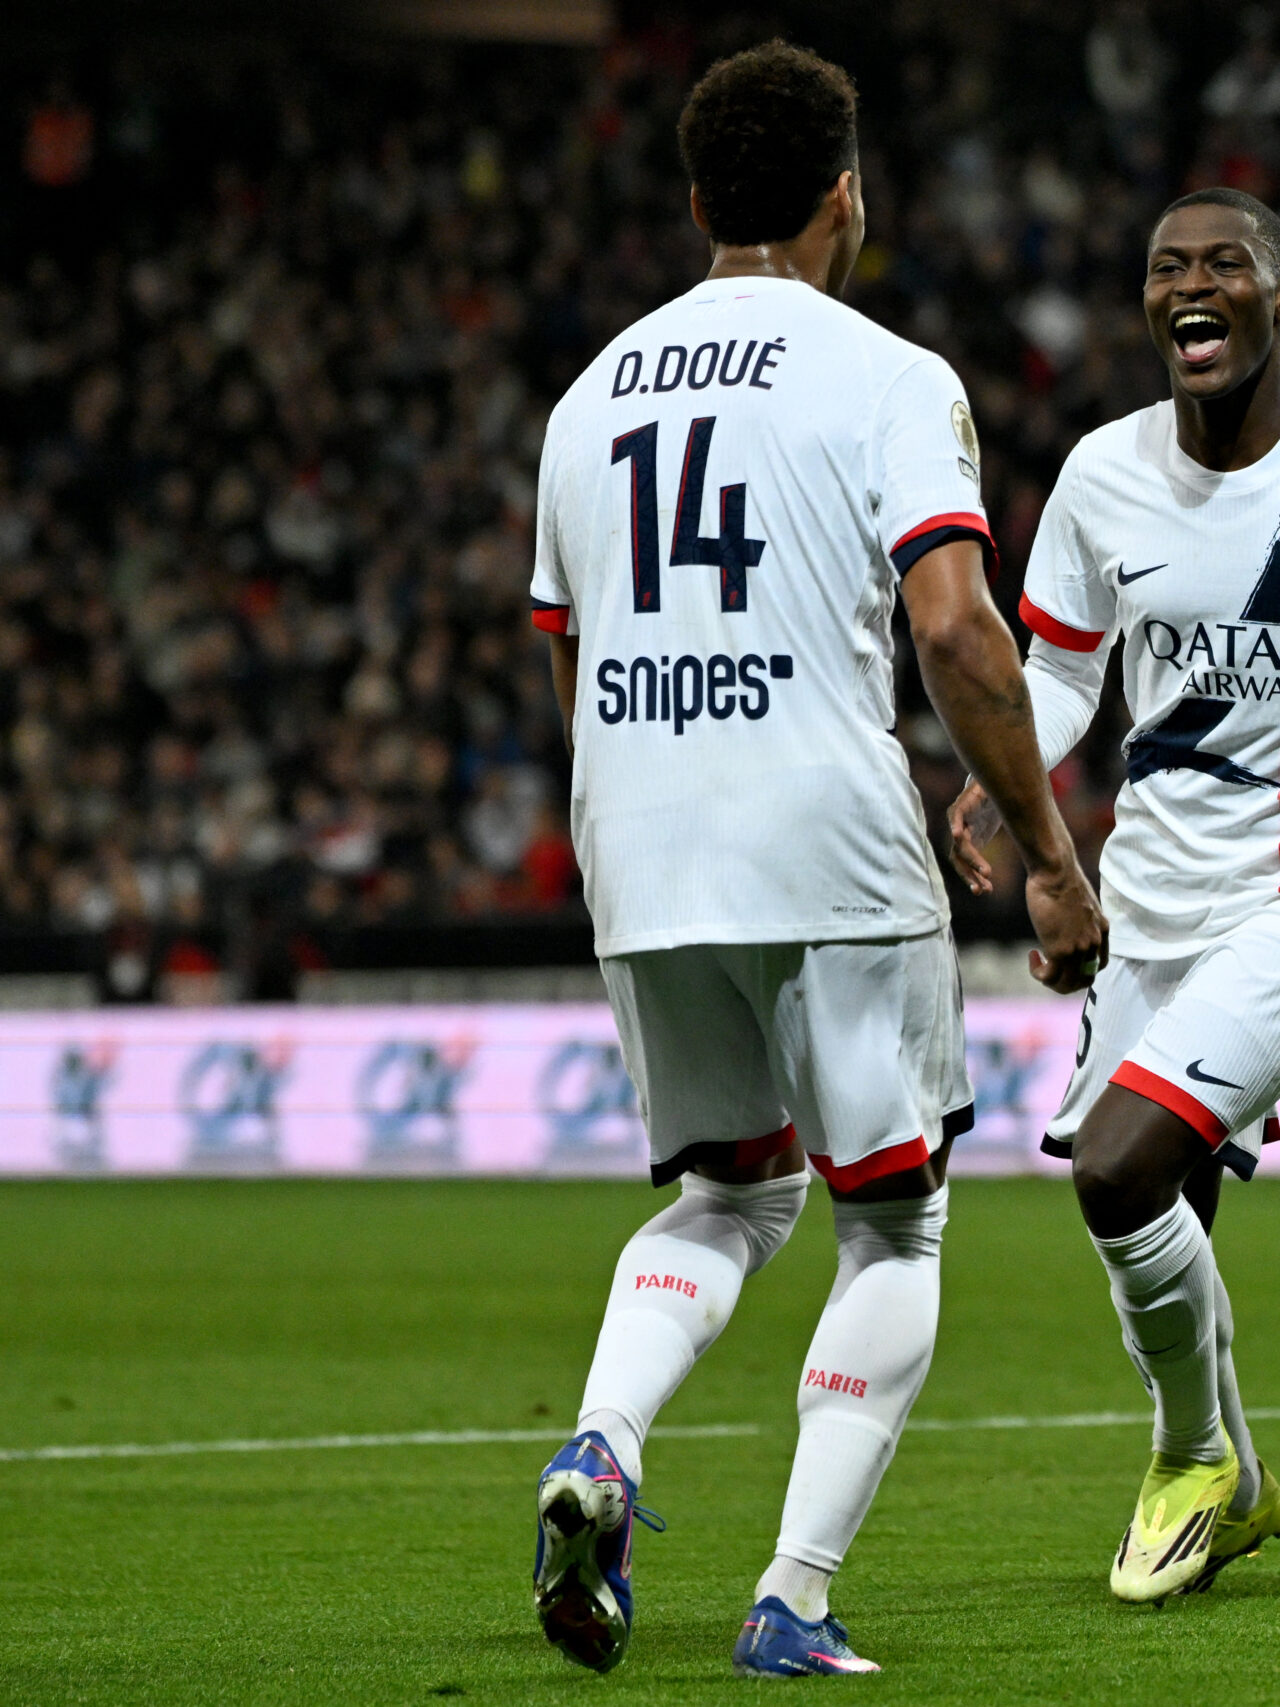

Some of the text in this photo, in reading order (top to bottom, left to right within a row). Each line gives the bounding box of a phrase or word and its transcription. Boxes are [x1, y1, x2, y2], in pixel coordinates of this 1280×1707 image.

[610, 336, 787, 400] D.DOUÉ
[611, 416, 766, 614] 14
[635, 1273, 698, 1299] PARIS
[805, 1368, 868, 1399] PARIS
